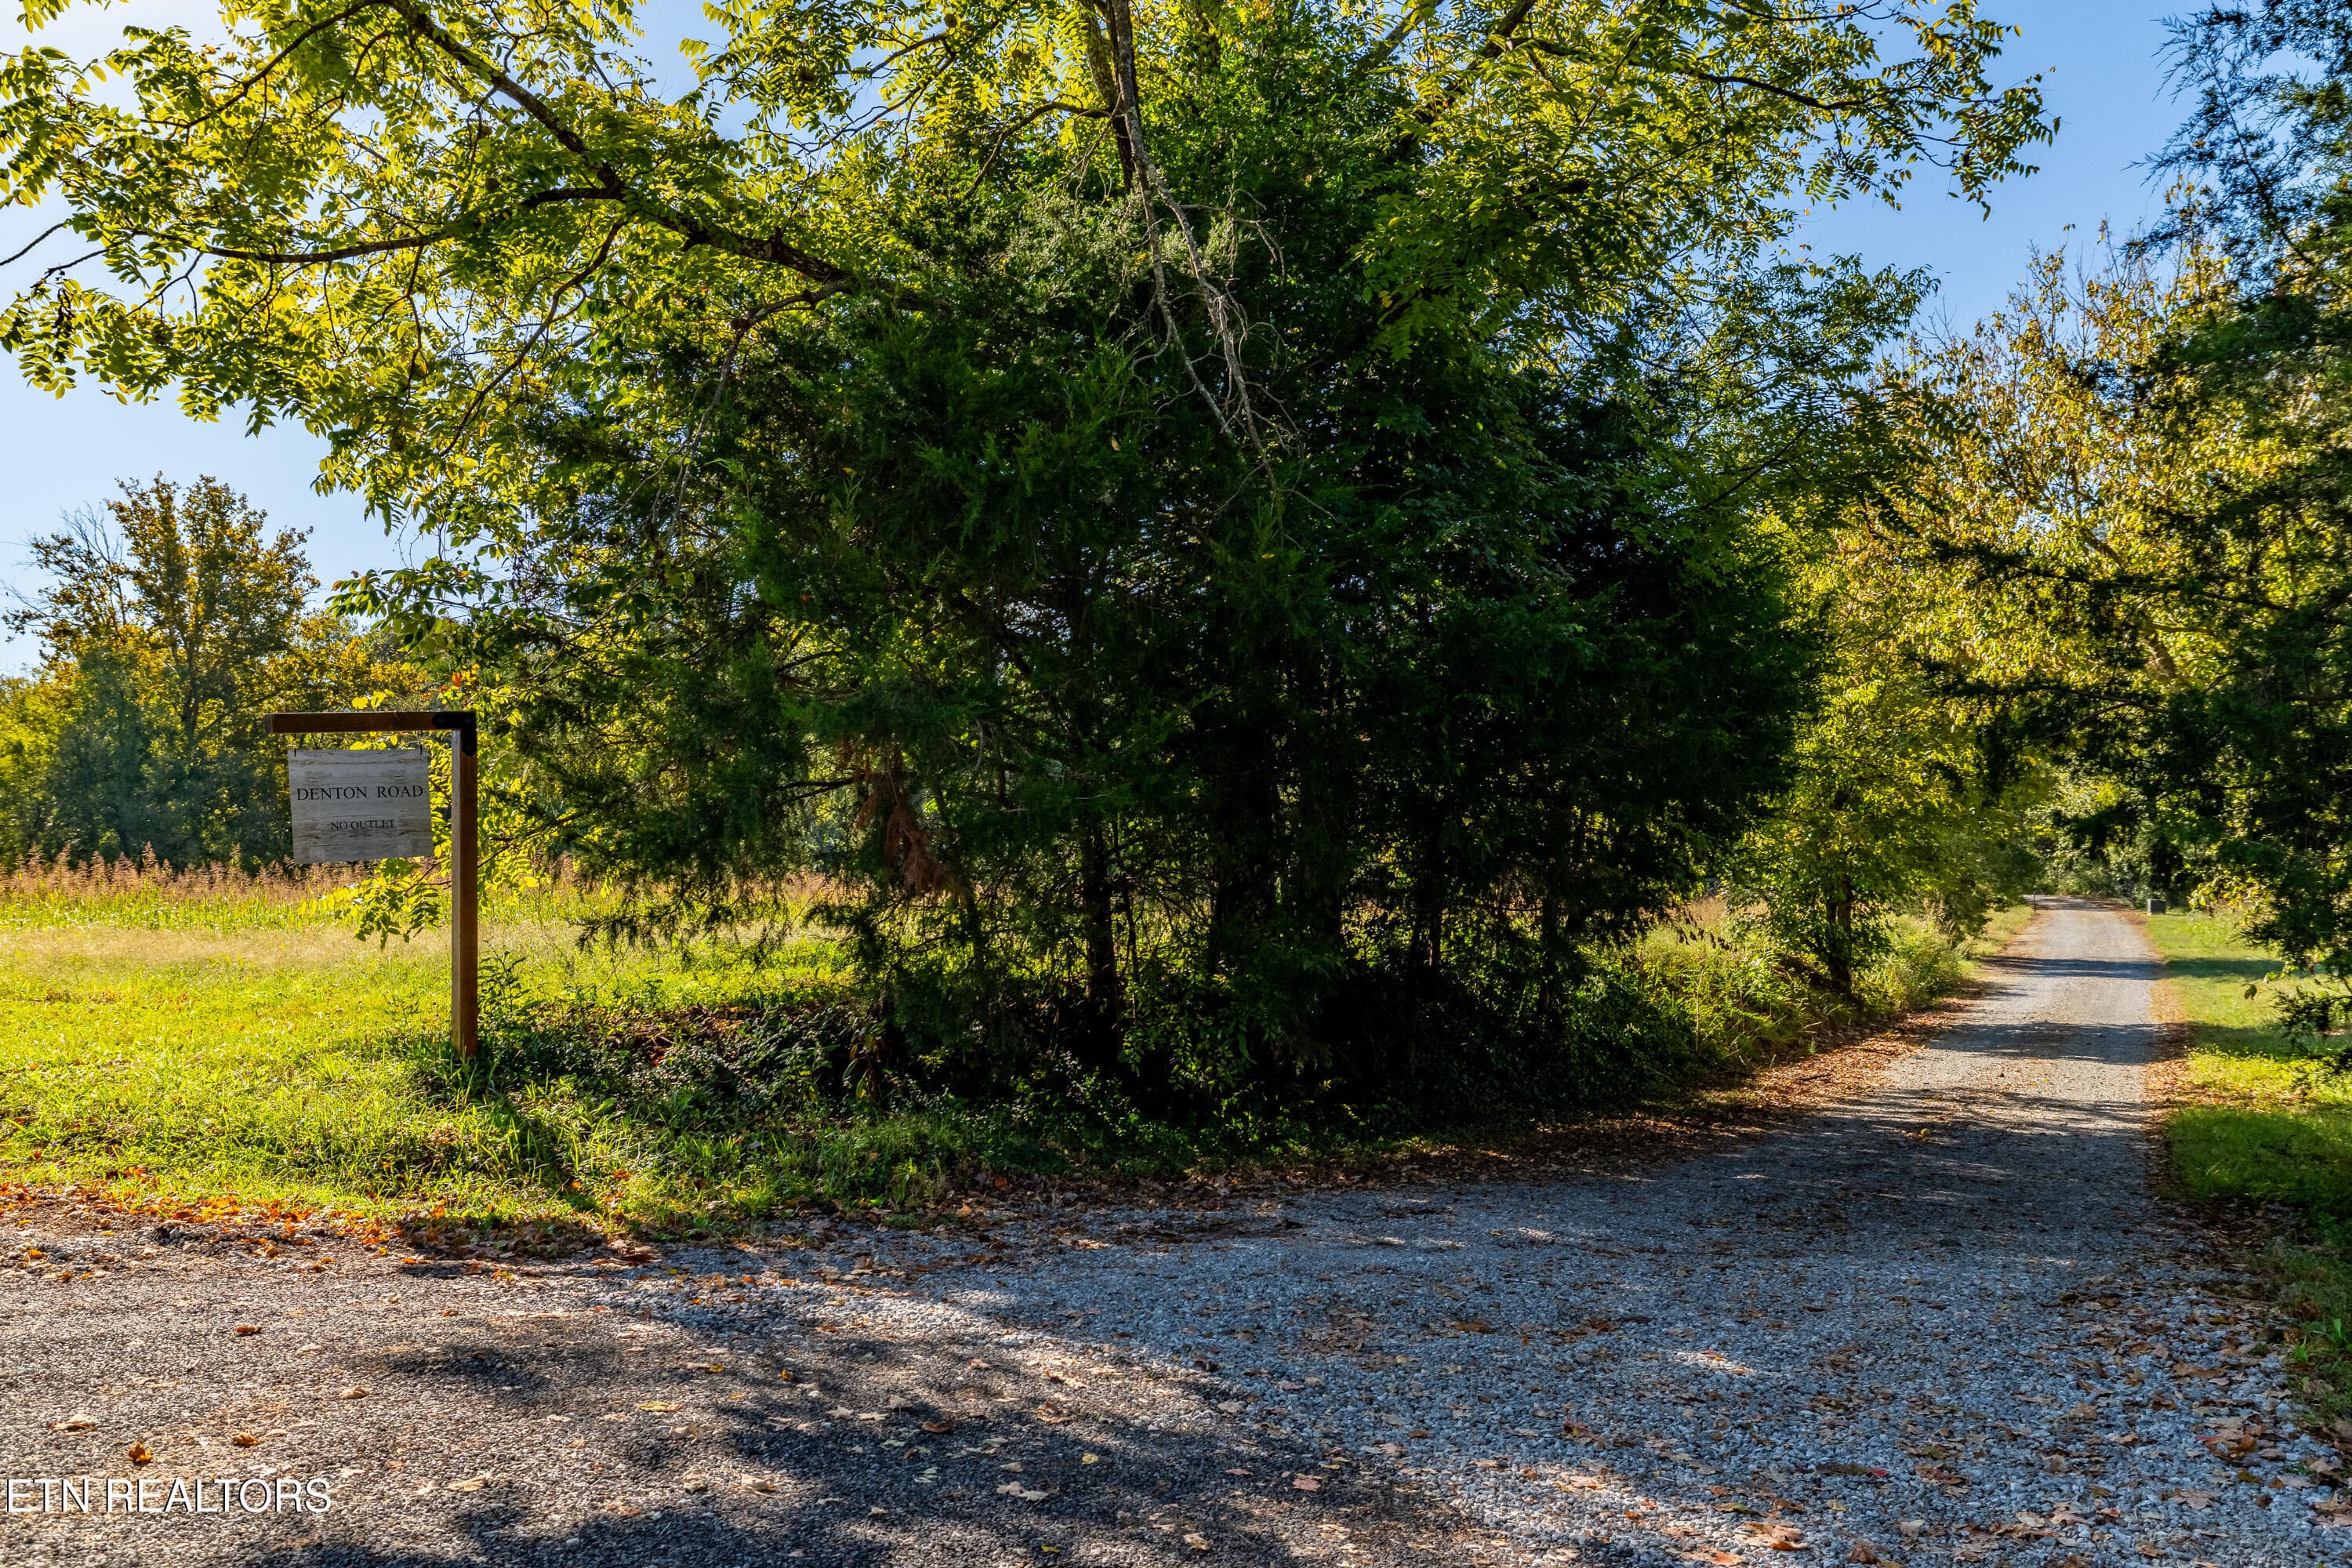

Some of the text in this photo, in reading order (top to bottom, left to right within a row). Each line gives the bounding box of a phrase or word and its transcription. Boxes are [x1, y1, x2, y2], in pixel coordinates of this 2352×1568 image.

[296, 785, 423, 800] DENTON ROAD
[331, 819, 395, 830] NO OUTLET
